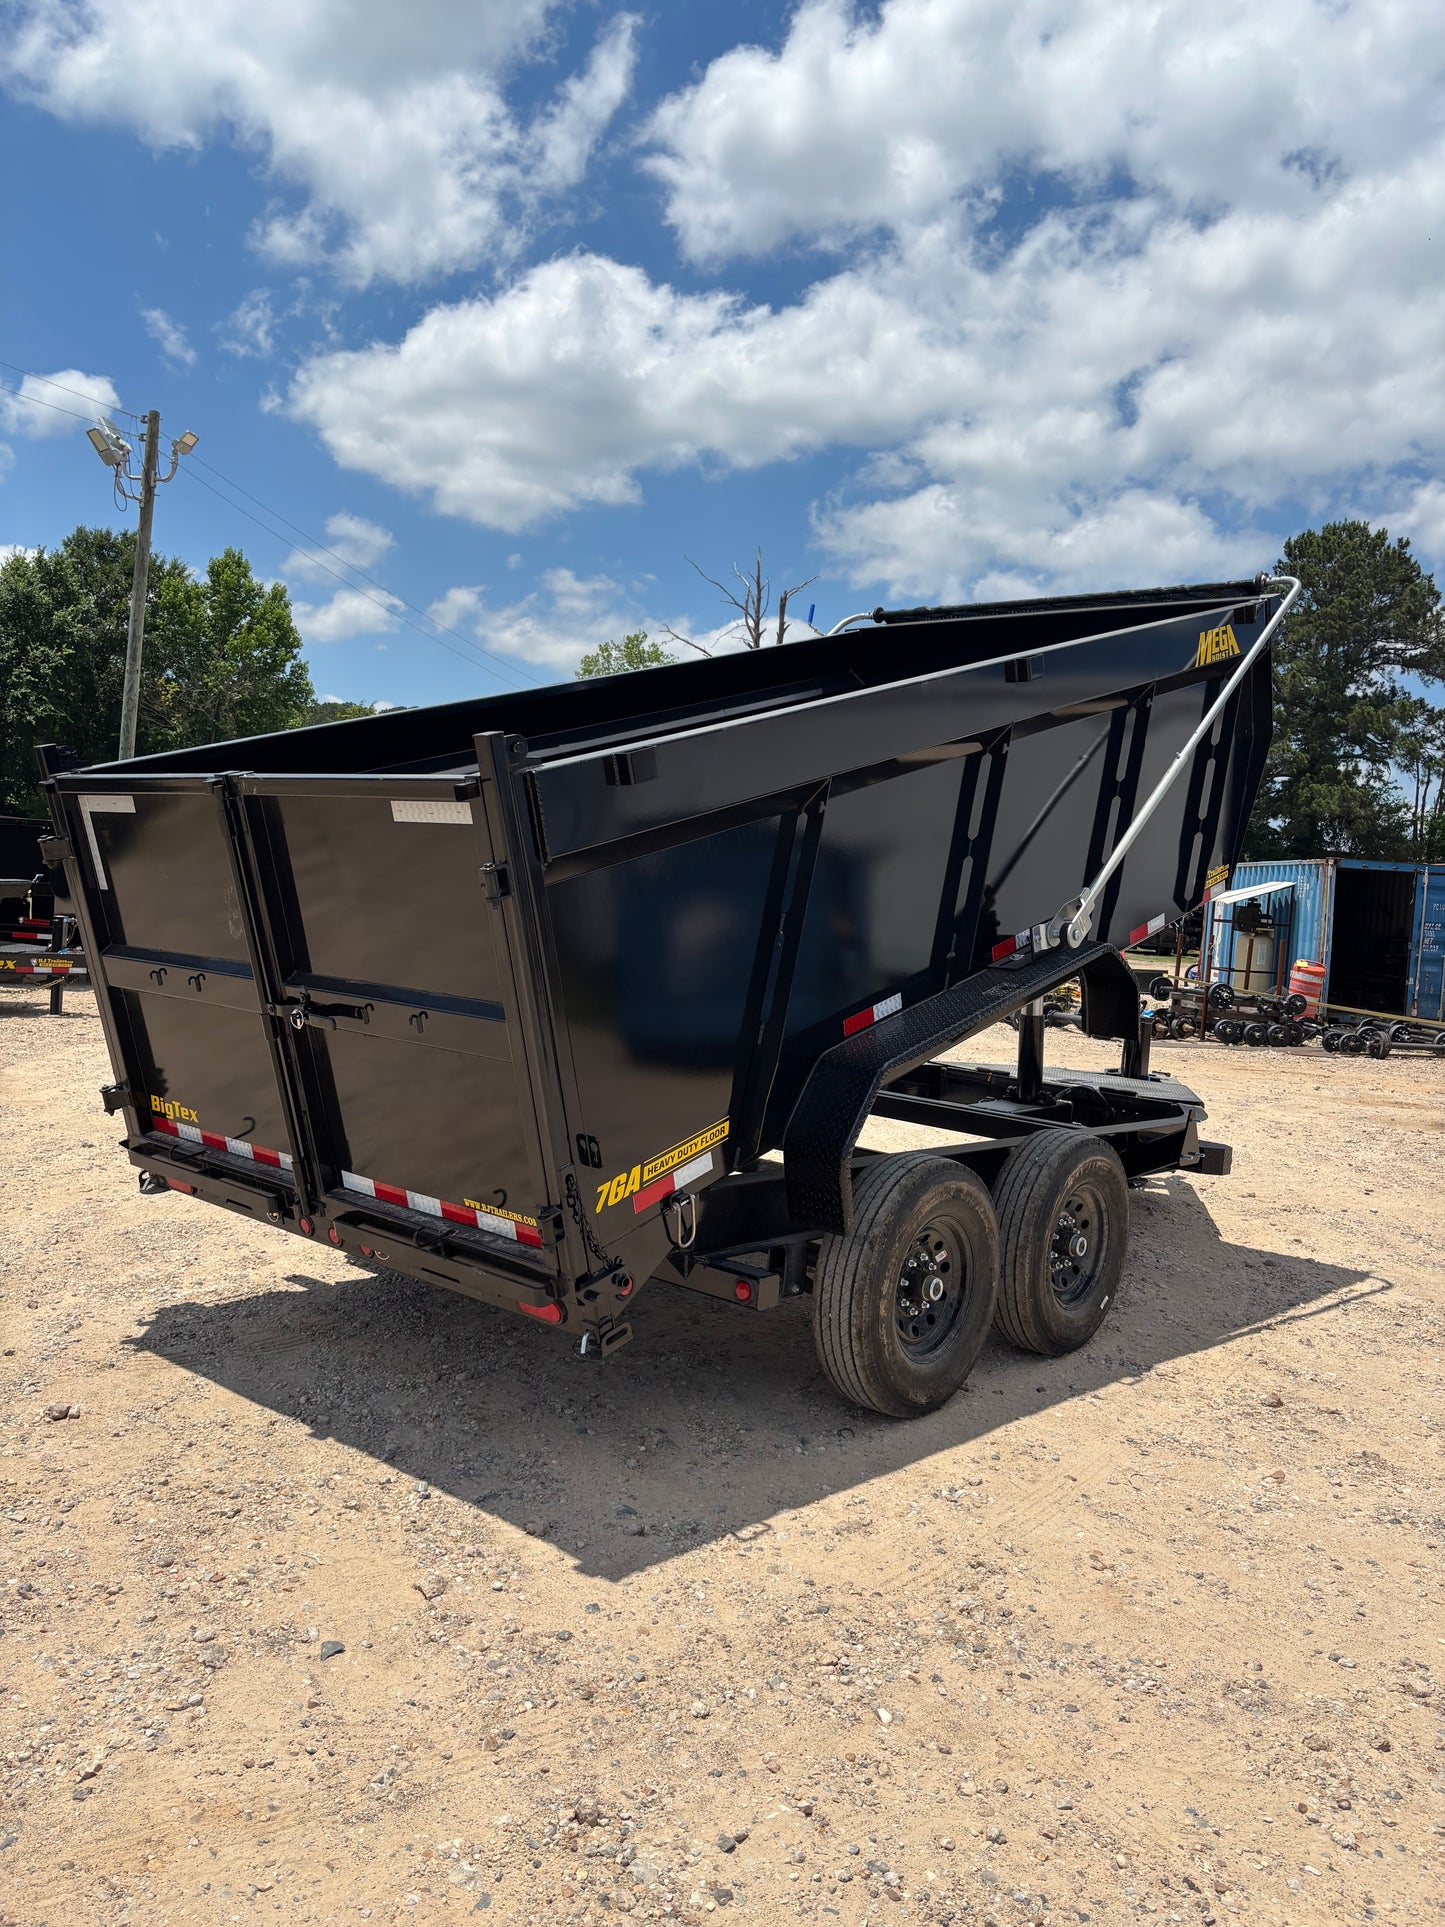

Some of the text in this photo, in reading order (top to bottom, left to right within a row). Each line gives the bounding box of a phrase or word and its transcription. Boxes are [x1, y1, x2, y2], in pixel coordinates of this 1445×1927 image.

[1195, 624, 1240, 667] MEGA
[1211, 650, 1229, 661] HOIST
[151, 1094, 199, 1123] BigTex
[596, 1125, 725, 1214] 7GA HEAVY DUTY FLOOR
